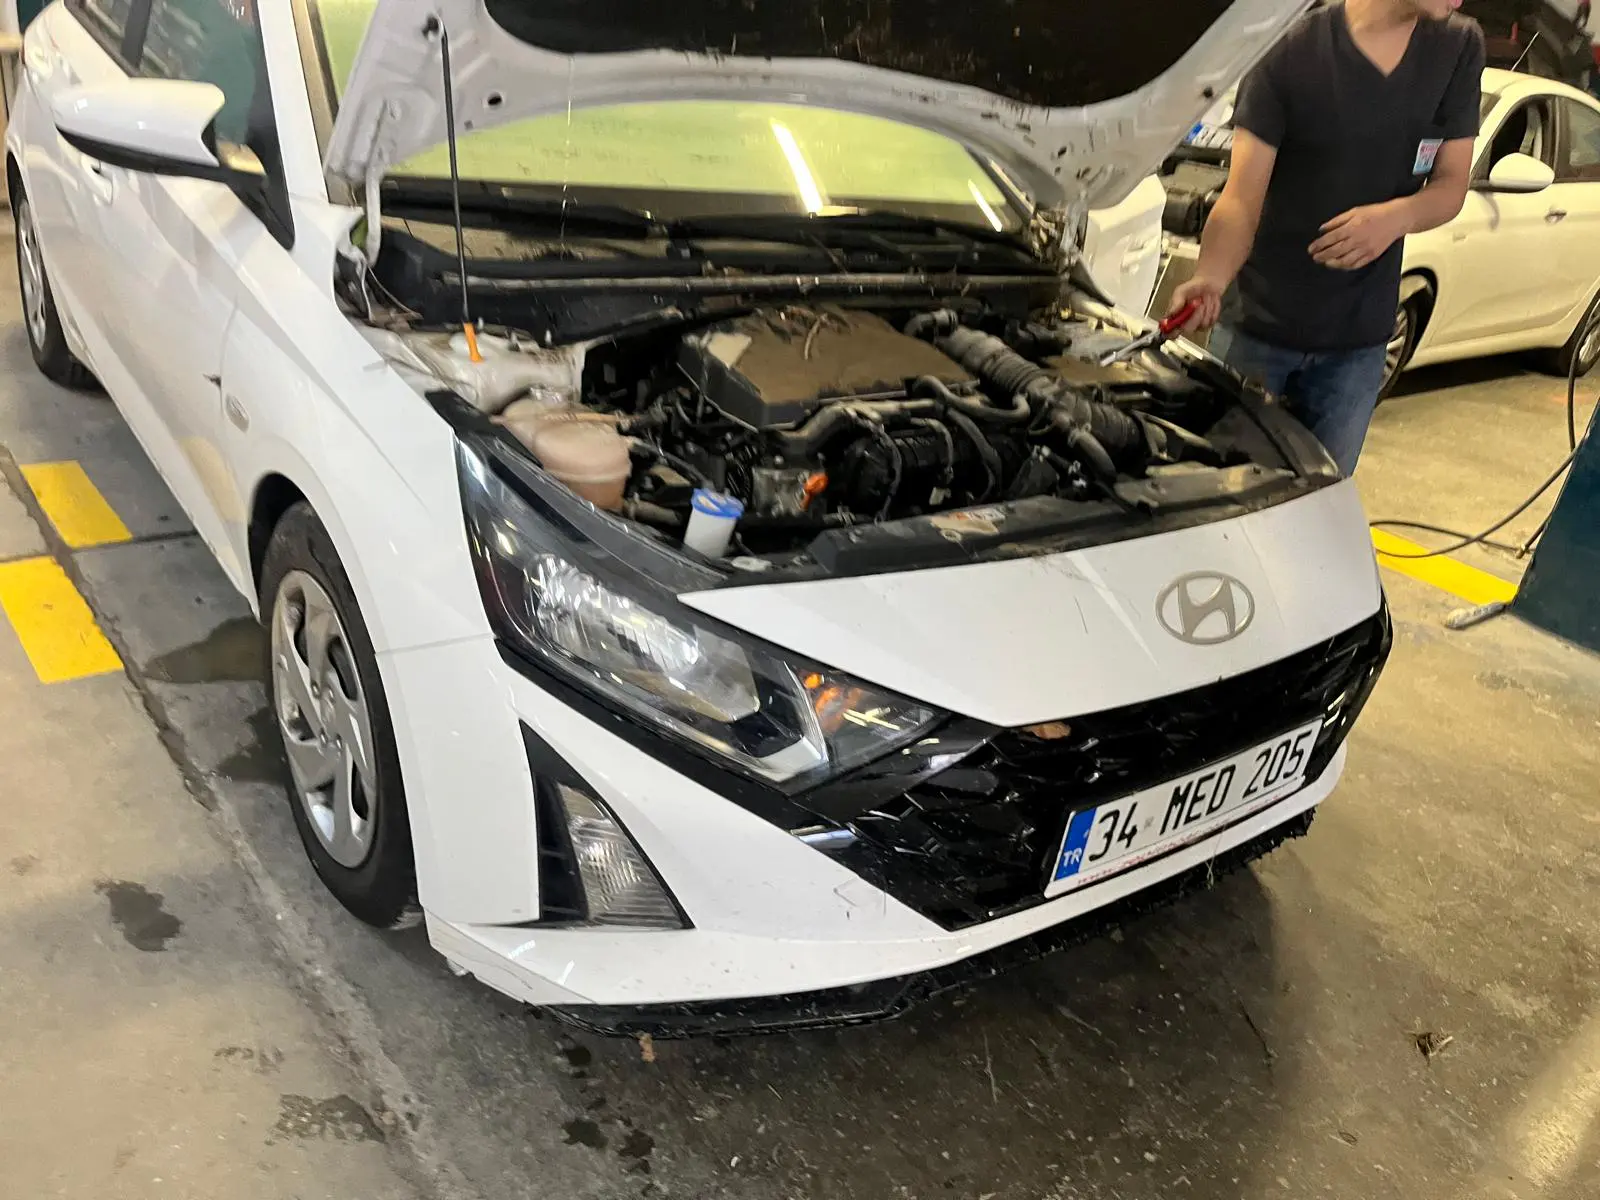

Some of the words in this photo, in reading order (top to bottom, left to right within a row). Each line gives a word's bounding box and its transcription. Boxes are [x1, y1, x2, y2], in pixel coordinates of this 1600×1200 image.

[1088, 801, 1138, 862] 34
[1159, 764, 1237, 836] MED
[1242, 730, 1313, 799] 205
[1063, 847, 1083, 867] TR
